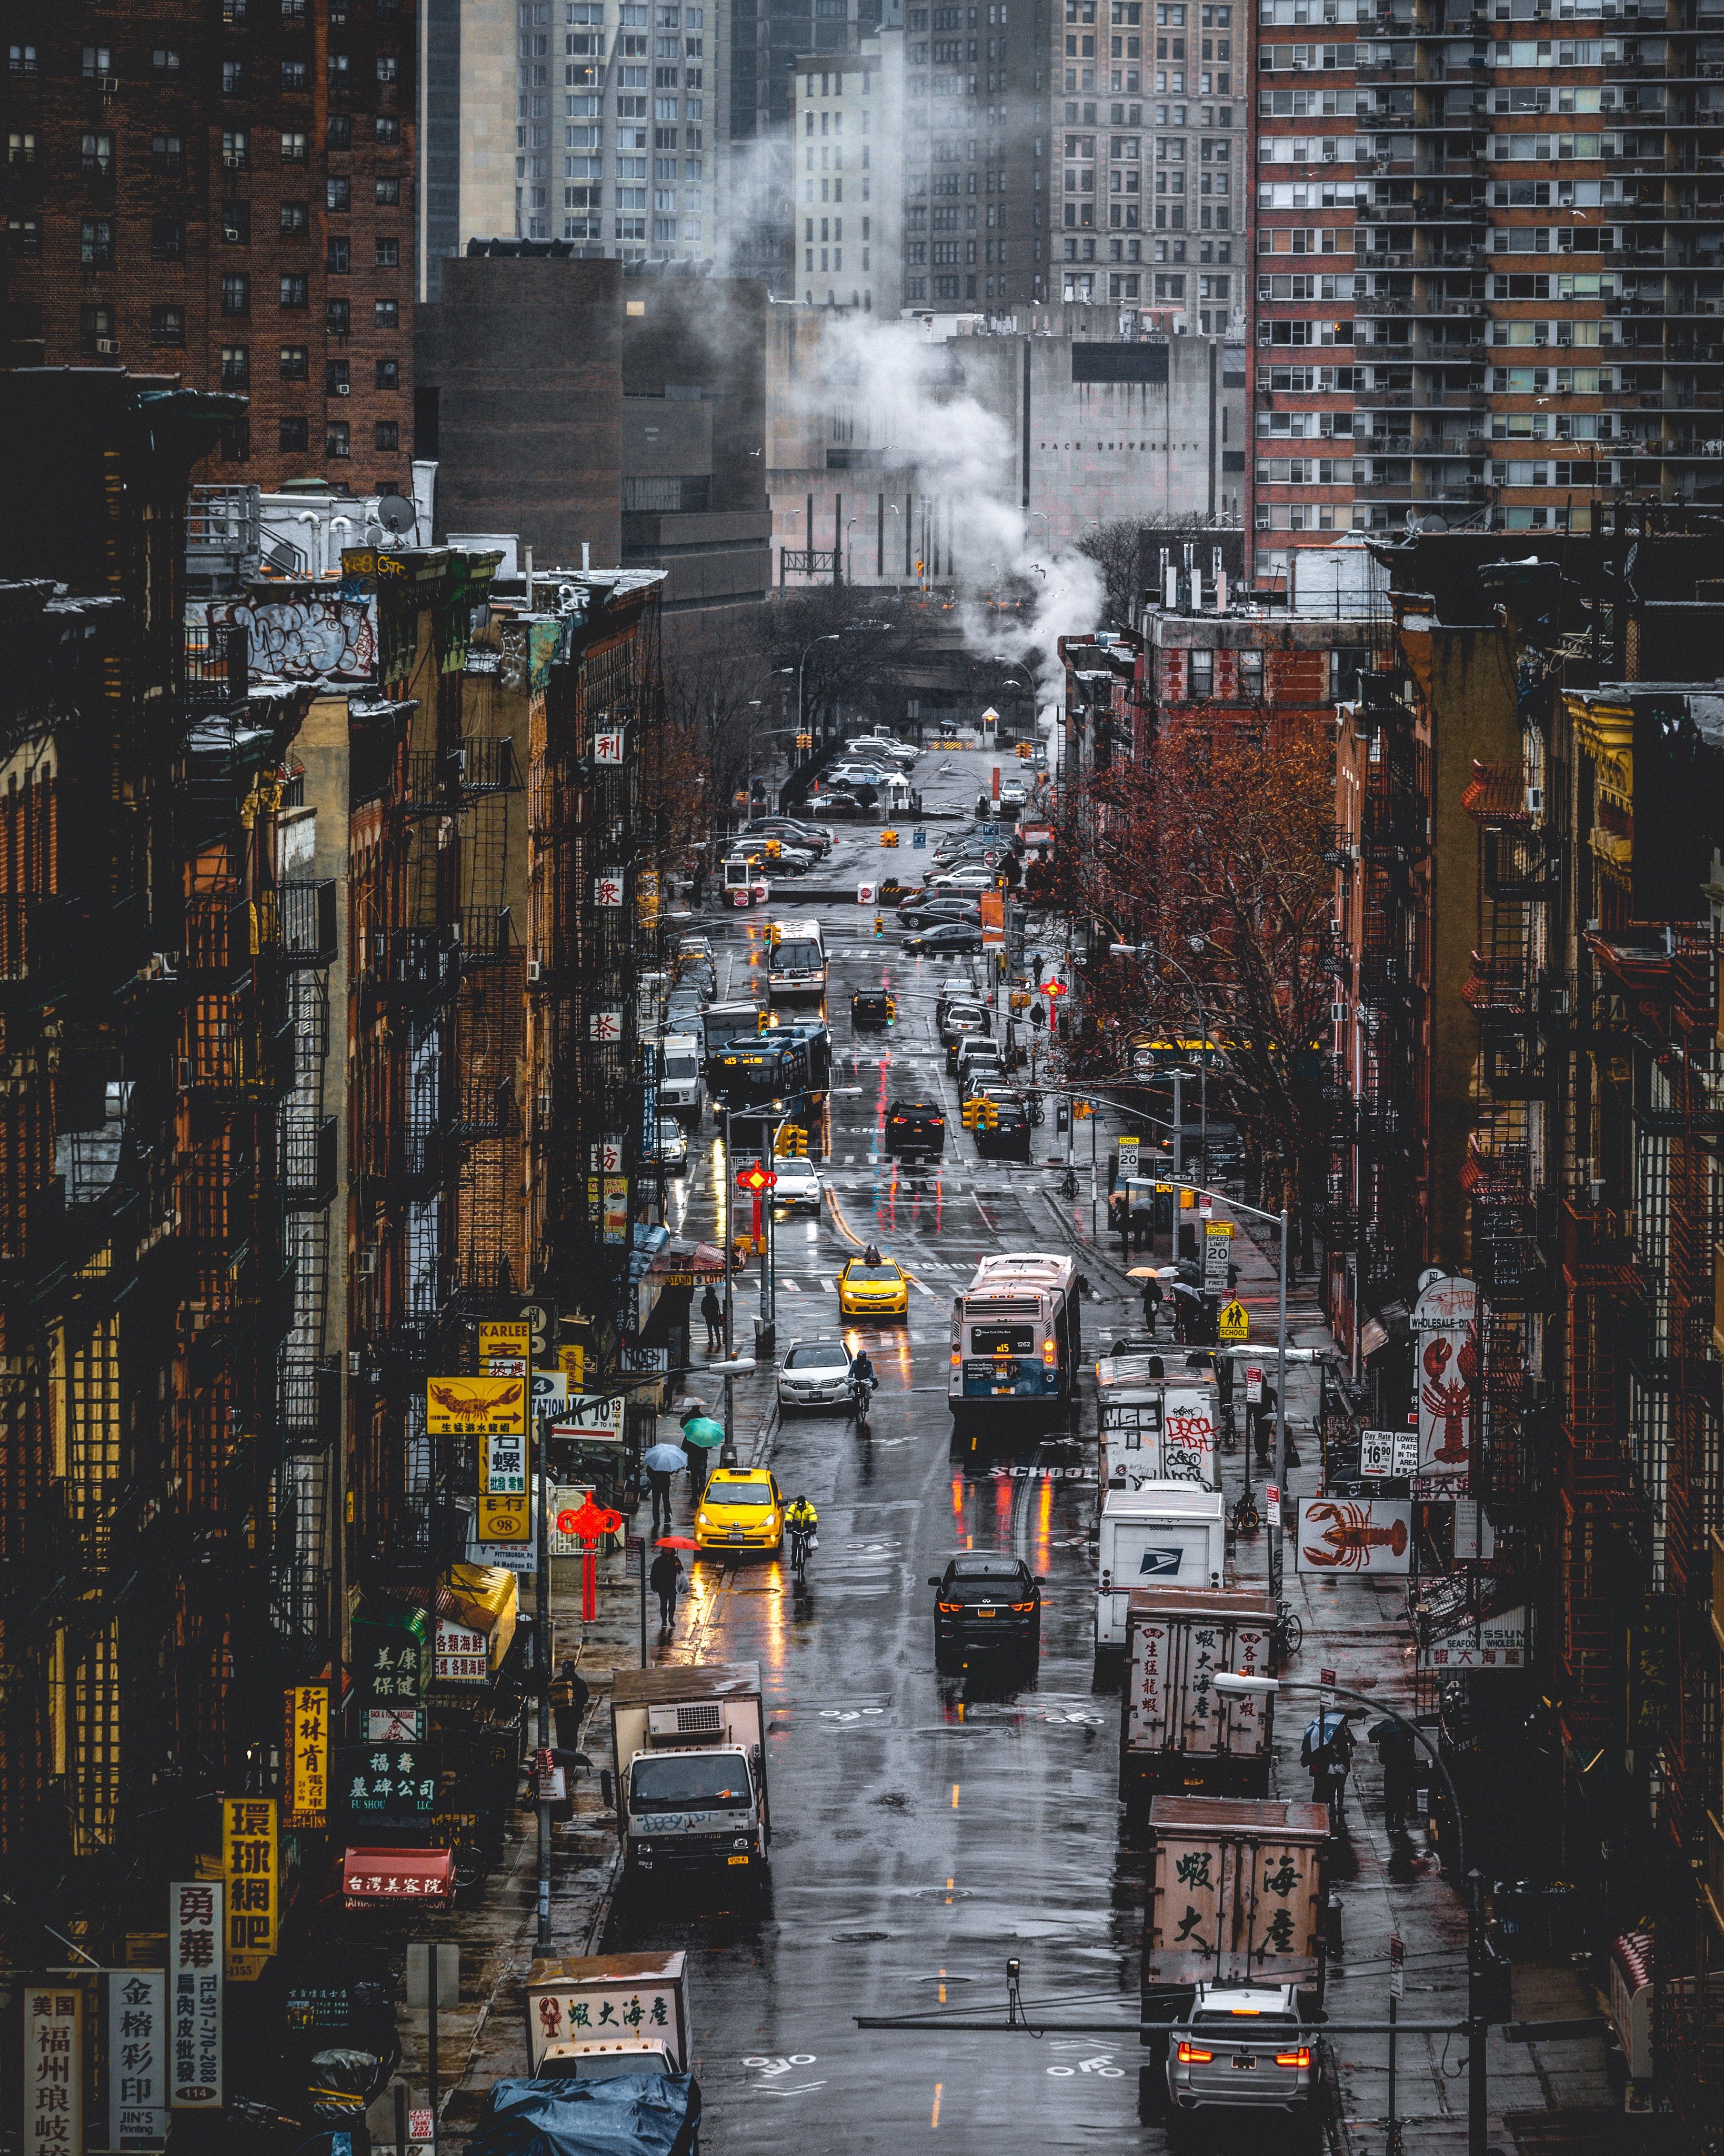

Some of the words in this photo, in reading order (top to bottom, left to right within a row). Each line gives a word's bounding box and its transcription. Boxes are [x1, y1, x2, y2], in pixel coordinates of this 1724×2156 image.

[1097, 442, 1199, 451] UNIVERSITY
[596, 735, 620, 761] 利
[590, 1015, 619, 1041] 茶
[1120, 1155, 1137, 1164] 20
[1207, 1248, 1227, 1259] 20
[905, 1262, 979, 1271] SCHOO
[705, 1274, 725, 1284] LOTT
[1411, 1318, 1455, 1328] WHOLESALE
[480, 1325, 527, 1337] KARLEE
[533, 1380, 546, 1392] 4
[611, 1400, 621, 1411] 13
[442, 1423, 509, 1433] 生猛游水龍蝦
[1365, 1432, 1376, 1441] Day
[1381, 1446, 1391, 1456] 90
[987, 1466, 1098, 1478] SCHOOL
[490, 1476, 506, 1491] 批發
[508, 1476, 524, 1491] 零售
[497, 1520, 513, 1531] 98
[436, 1634, 483, 1653] 各類海鮮
[1447, 1640, 1477, 1648] SEAFOO
[1487, 1639, 1524, 1648] WHOLESAL
[374, 1646, 418, 1671] 美康
[452, 1658, 485, 1676] 各類海鮮
[1142, 1641, 1159, 1713] 生猛龍蝦
[372, 1675, 417, 1696] 保健
[370, 1710, 380, 1719] BACK
[397, 1711, 414, 1719] MASSAGE
[296, 1689, 327, 1773] 新林肯
[369, 1752, 415, 1773] 福壽
[307, 1774, 324, 1808] 電召車
[349, 1776, 435, 1801] 墓碑公司
[352, 1801, 362, 1809] FU
[364, 1801, 385, 1810] SHOU
[417, 1801, 433, 1810] LLC.
[292, 1816, 327, 1828] 274-1188
[230, 1803, 270, 1949] 環球網吧
[348, 1875, 443, 1894] 台灣美容院
[1174, 1852, 1215, 1950] 蝦大
[179, 1886, 214, 1968] 勇華
[33, 1996, 75, 2017] 美国
[120, 1978, 153, 2103] 金榕彩印
[184, 2088, 206, 2098] 114
[120, 2111, 153, 2124] JIN'S
[120, 2124, 153, 2135] Printing
